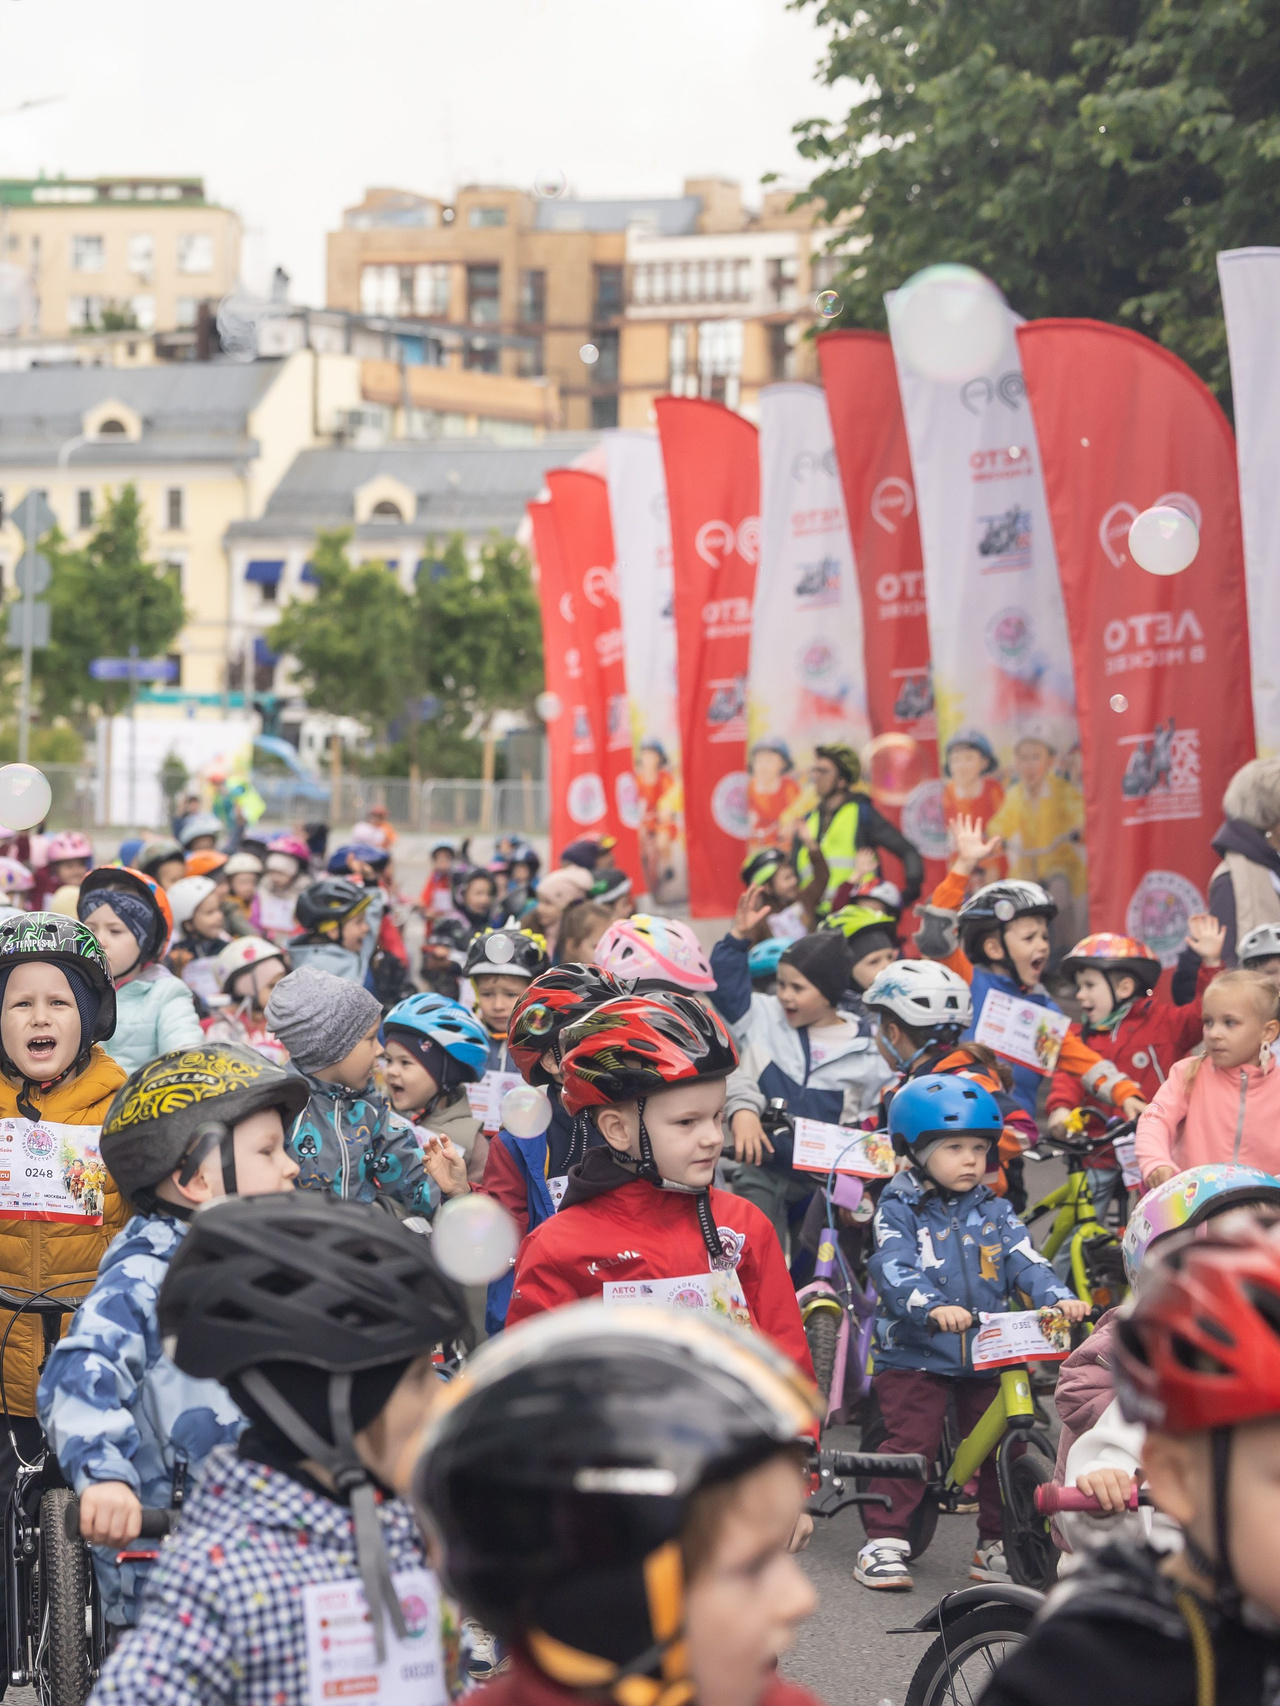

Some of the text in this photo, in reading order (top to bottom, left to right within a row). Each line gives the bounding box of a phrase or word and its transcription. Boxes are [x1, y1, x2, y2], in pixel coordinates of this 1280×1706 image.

[16, 940, 57, 949] TEMPESTA
[146, 1073, 216, 1091] KELLYS
[25, 1168, 53, 1178] 0248
